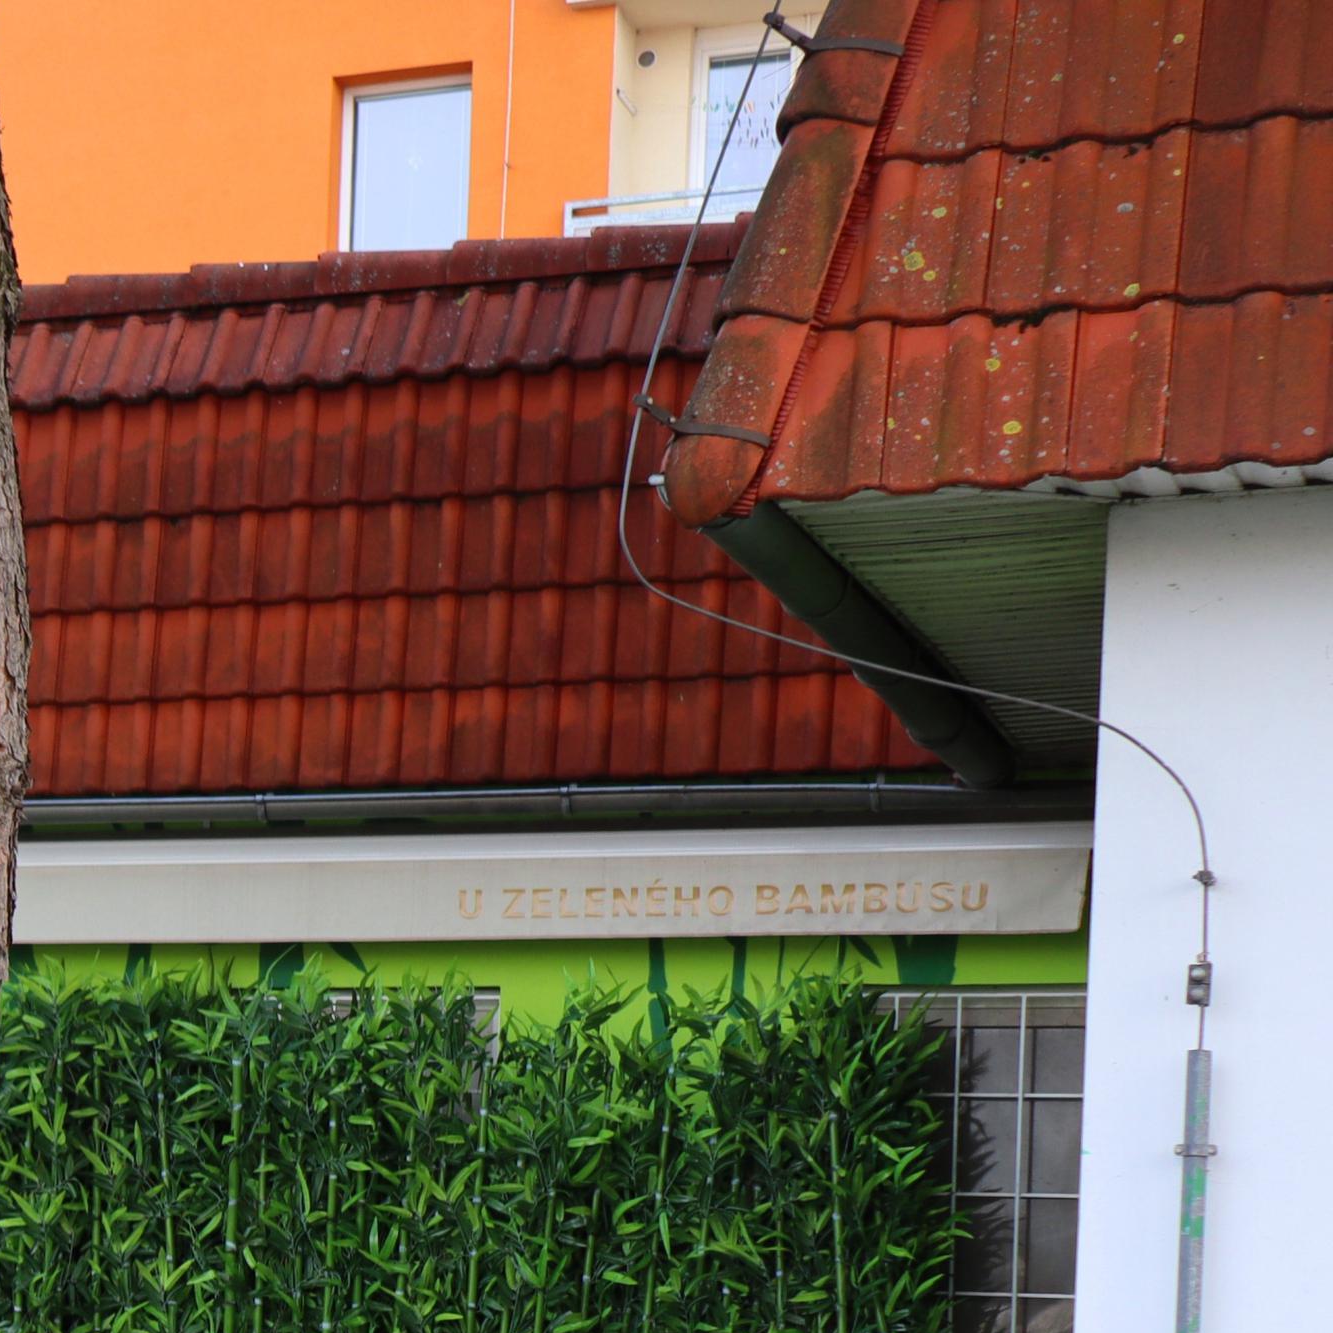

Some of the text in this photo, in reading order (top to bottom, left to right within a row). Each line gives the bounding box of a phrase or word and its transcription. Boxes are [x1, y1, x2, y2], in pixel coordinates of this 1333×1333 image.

[458, 878, 989, 919] U ZELENÉHO BAMBUSU
